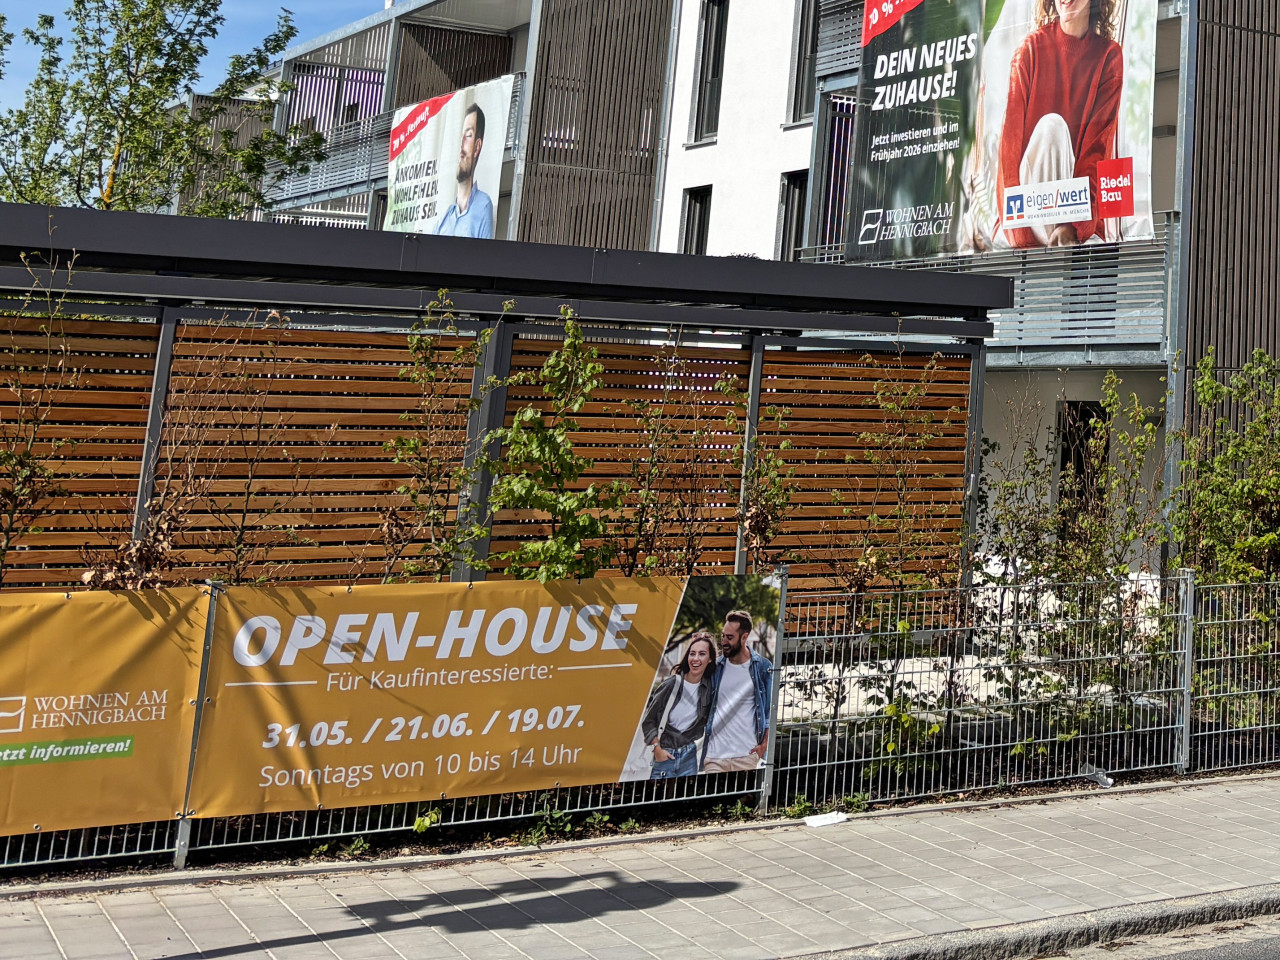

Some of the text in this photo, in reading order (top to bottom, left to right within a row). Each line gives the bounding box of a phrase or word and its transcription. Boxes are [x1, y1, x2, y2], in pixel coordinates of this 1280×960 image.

[873, 33, 978, 79] DEIN NEUES
[872, 70, 958, 111] ZUHAUSE!
[871, 121, 959, 148] Jetzt investieren und im
[870, 136, 960, 162] Frühjahr 2026 einziehen!
[1100, 174, 1131, 189] Riedel
[1101, 190, 1122, 203] Bau
[886, 202, 955, 224] WOHNEN AM
[879, 219, 953, 240] HENNIGBACH
[233, 603, 639, 667] OPEN-HOUSE
[326, 663, 554, 692] Für Kaufinteressierte:
[33, 689, 169, 712] WOHNEN AM
[30, 705, 168, 730] HENNIGBACH
[261, 704, 585, 749] 31.05. / 21.06. / 19.07.
[0, 739, 132, 762] tzt informieren!
[258, 743, 583, 789] Sonntags von 10 bis 14 Uhr
